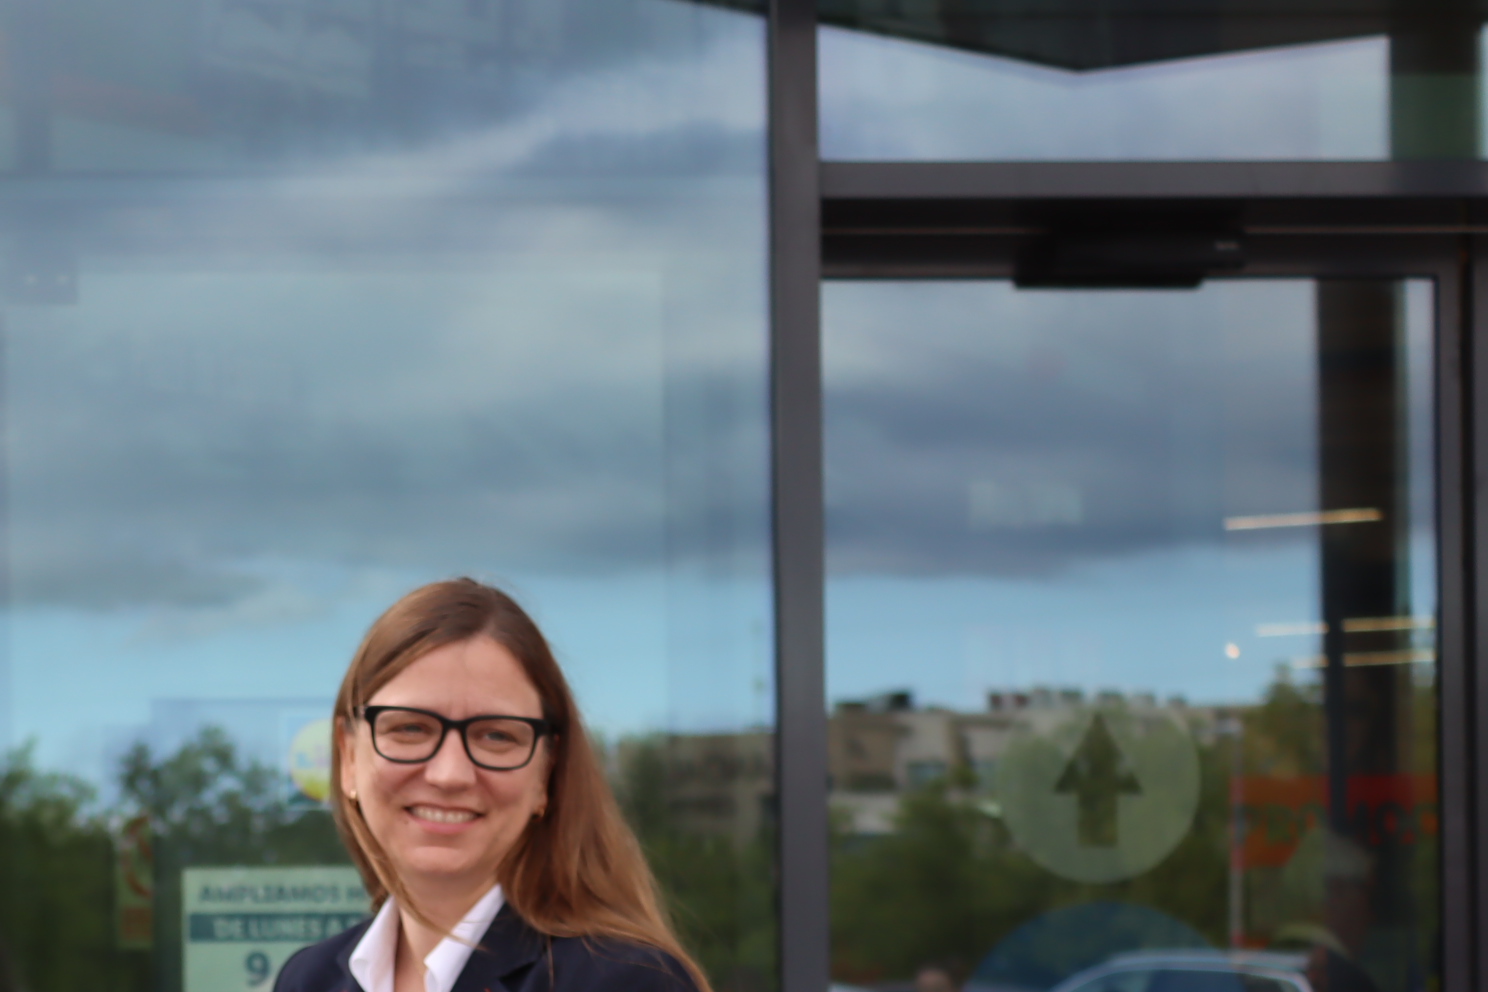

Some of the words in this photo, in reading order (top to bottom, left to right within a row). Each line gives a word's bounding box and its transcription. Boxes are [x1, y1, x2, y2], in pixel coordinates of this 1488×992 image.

[214, 917, 242, 938] DE
[247, 917, 321, 938] LUNES
[246, 951, 270, 988] 9
